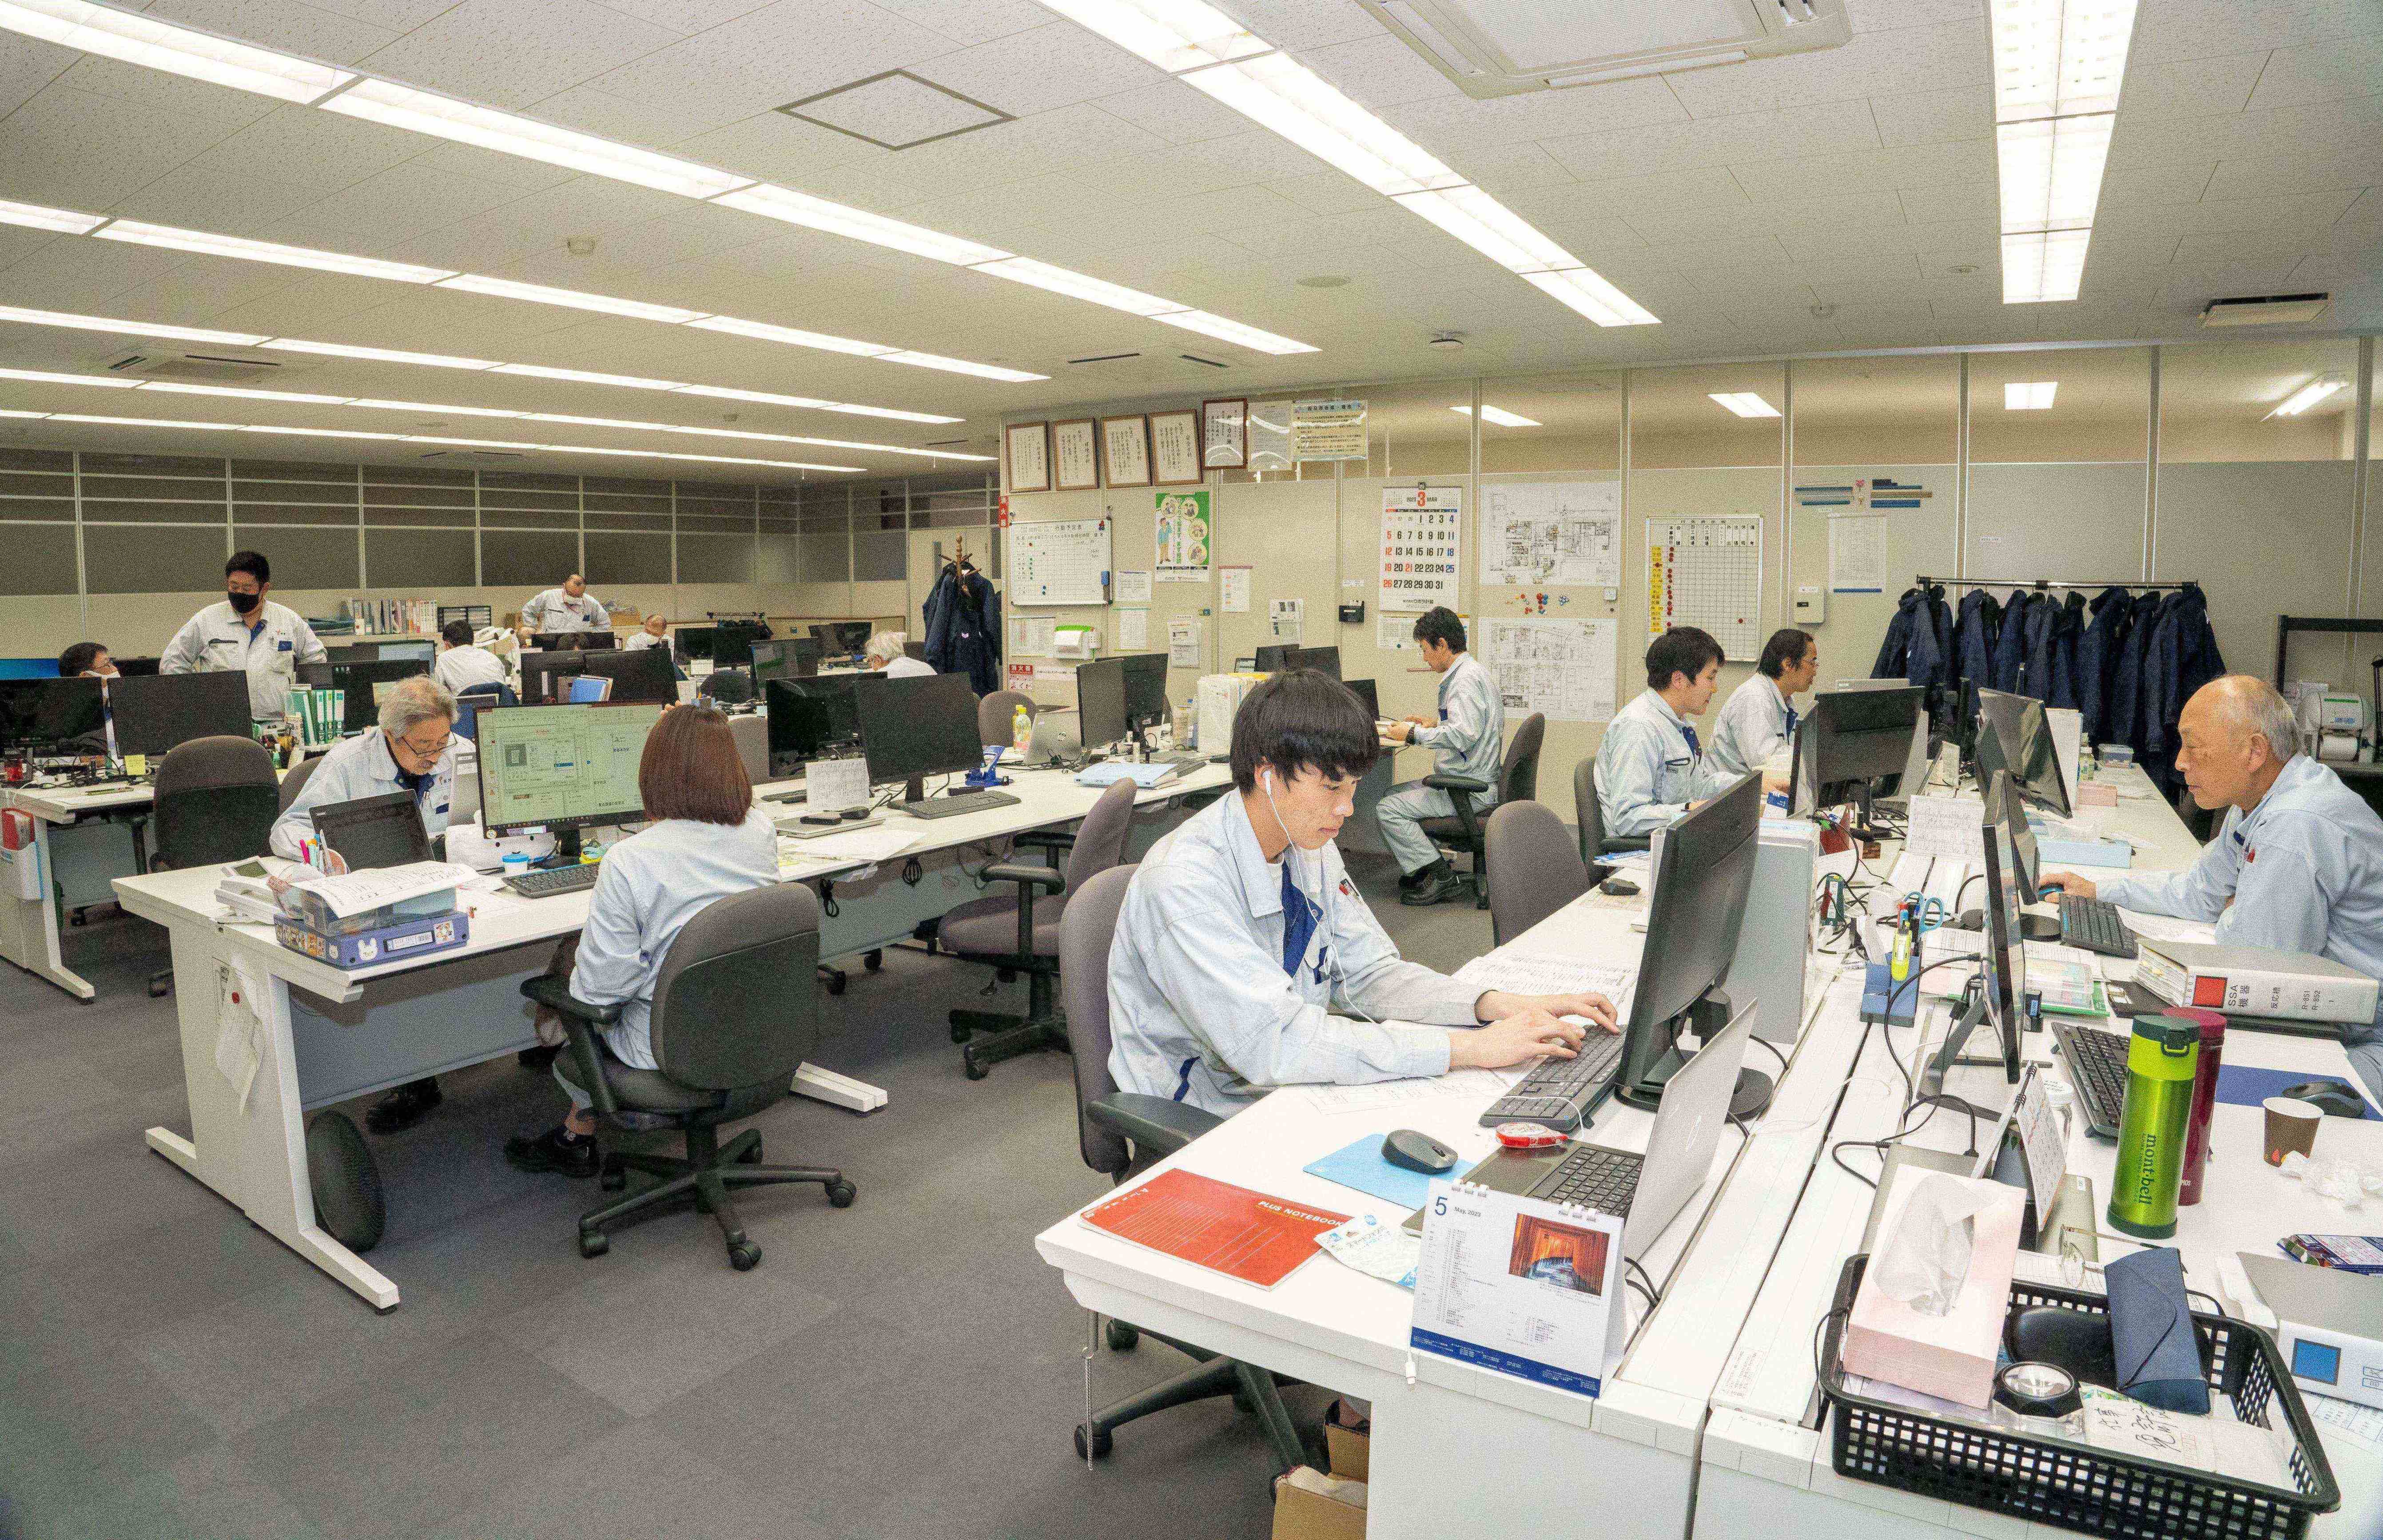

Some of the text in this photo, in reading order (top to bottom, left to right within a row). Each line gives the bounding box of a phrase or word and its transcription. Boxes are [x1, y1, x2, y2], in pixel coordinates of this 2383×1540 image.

[1417, 491, 1426, 507] 3
[1419, 515, 1422, 523] 1
[1428, 515, 1433, 523] 2
[1439, 515, 1444, 523] 3
[1387, 531, 1392, 539] 5
[1397, 531, 1402, 539] 6
[1418, 531, 1423, 540] 8
[1428, 531, 1433, 540] 9
[1437, 531, 1444, 540] 10
[1448, 531, 1454, 540] 11
[1385, 547, 1454, 557] 12 13 14 15 16 17 18
[1384, 563, 1392, 572] 19
[1405, 564, 1412, 572] 21
[1415, 564, 1424, 572] 22
[1425, 564, 1434, 572] 23
[1435, 564, 1444, 572] 24
[1445, 564, 1454, 573] 25
[1383, 579, 1443, 589] 26 27 28 29 30 31
[2228, 984, 2238, 1007] SSA
[2238, 984, 2250, 1008] 機器
[2270, 987, 2281, 1009] 反応槽
[2302, 990, 2311, 1010] R-851
[2312, 990, 2321, 1011] R-852
[1257, 1200, 1282, 1211] PLUS
[1434, 1196, 1448, 1216] 5
[1454, 1206, 1467, 1215] May,
